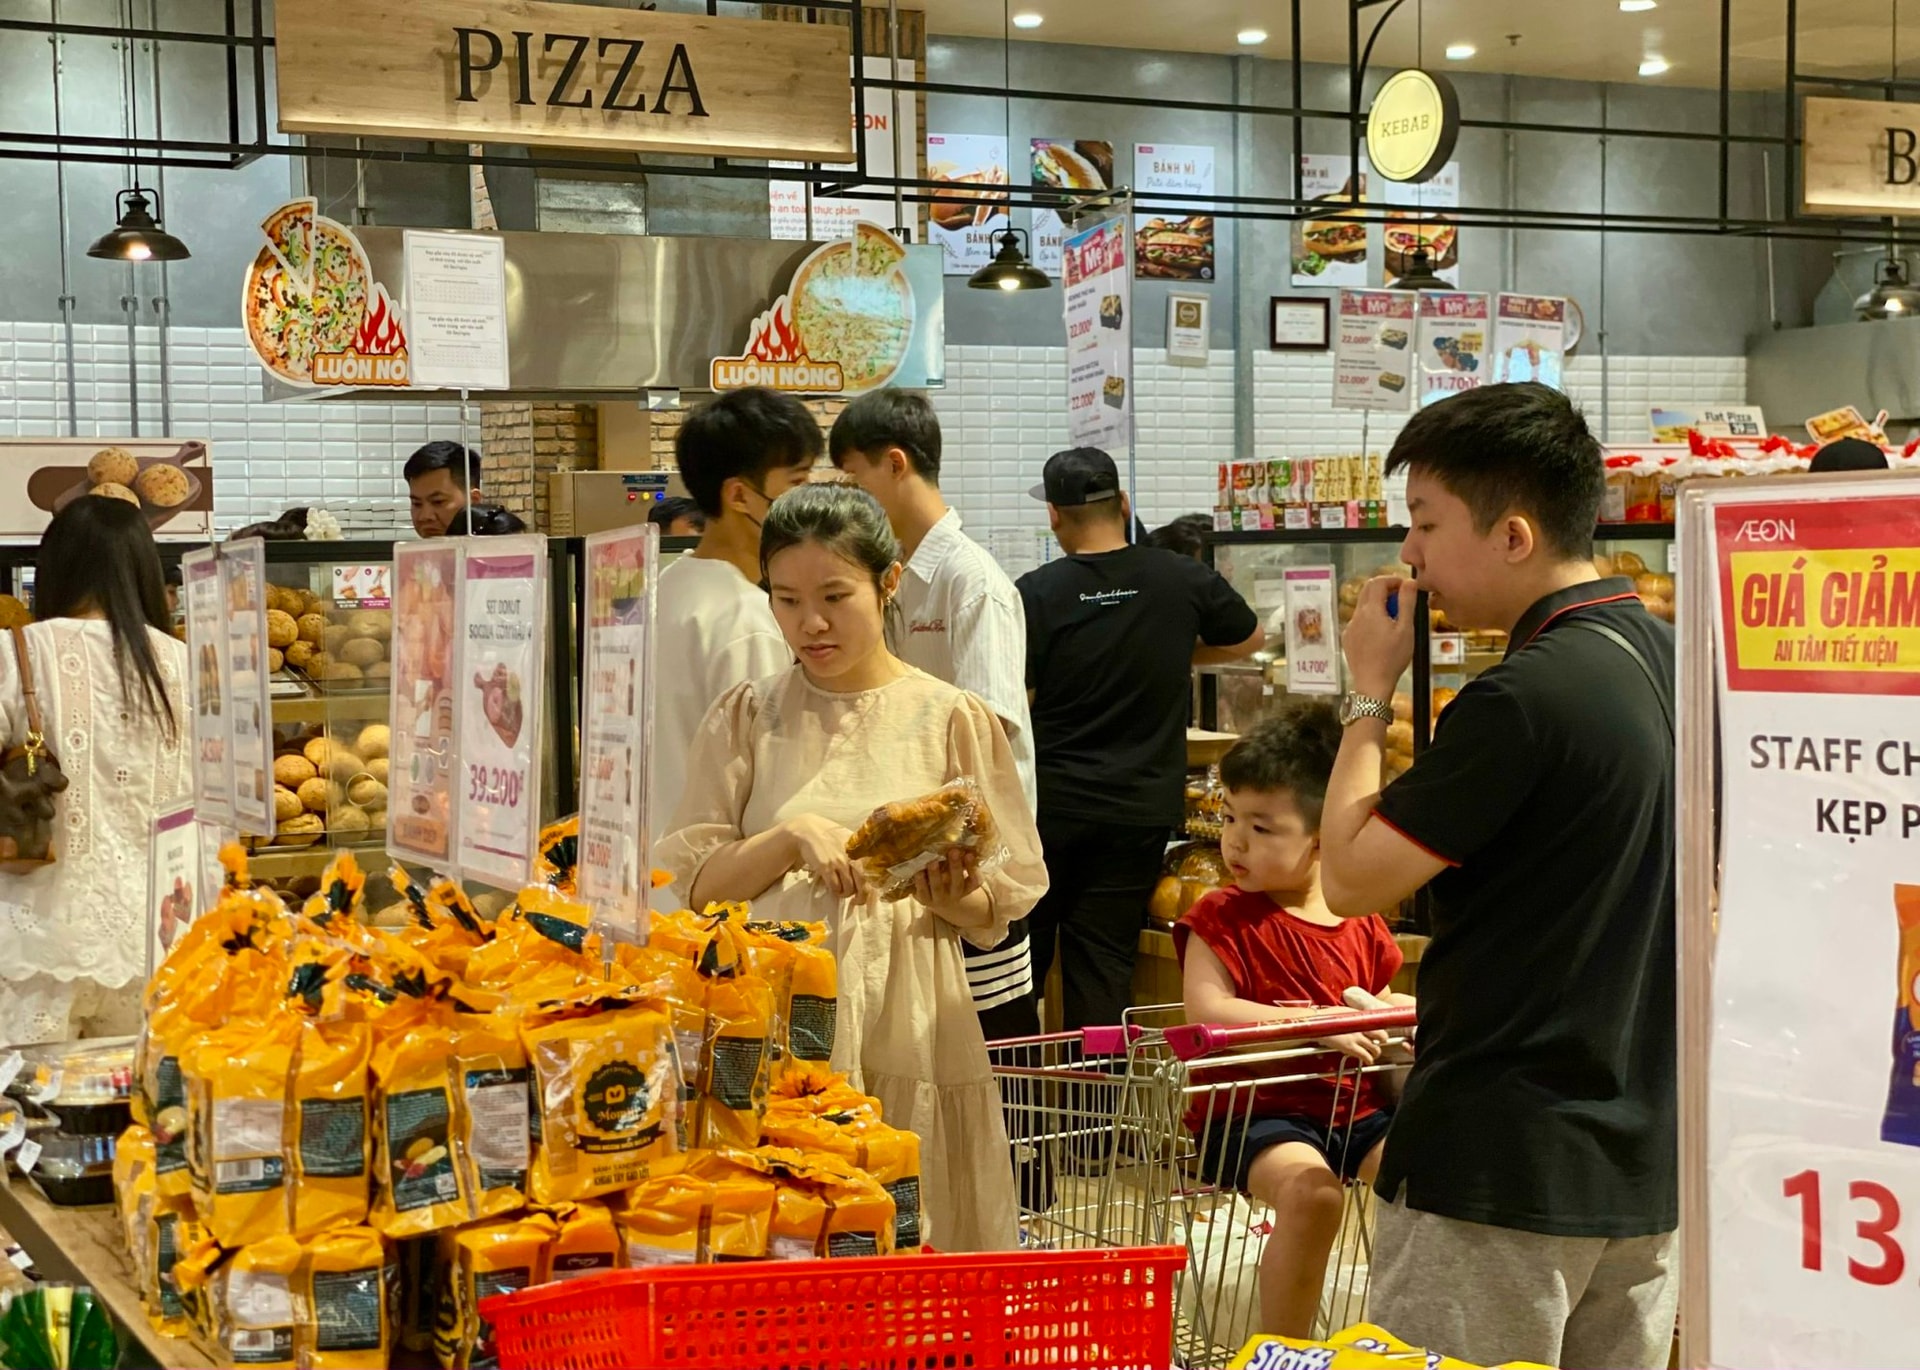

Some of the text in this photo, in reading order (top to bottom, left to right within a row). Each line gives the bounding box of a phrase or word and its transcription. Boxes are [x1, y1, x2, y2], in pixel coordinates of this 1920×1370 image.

[453, 27, 710, 117] PIZZA
[1381, 114, 1430, 138] KEBAB
[1153, 159, 1180, 174] BÁNH
[1884, 126, 1920, 186] B
[317, 352, 373, 380] LUÔN
[717, 360, 839, 387] LUÔN NÓNG
[1705, 411, 1753, 423] Flat Pizza
[498, 599, 521, 616] DONUT
[1741, 555, 1920, 629] GIÁ GIẢM
[1774, 633, 1899, 667] AN TÂM TIẾT KIỆM
[1749, 734, 1862, 774] STAFF
[1816, 798, 1887, 844] KẸP
